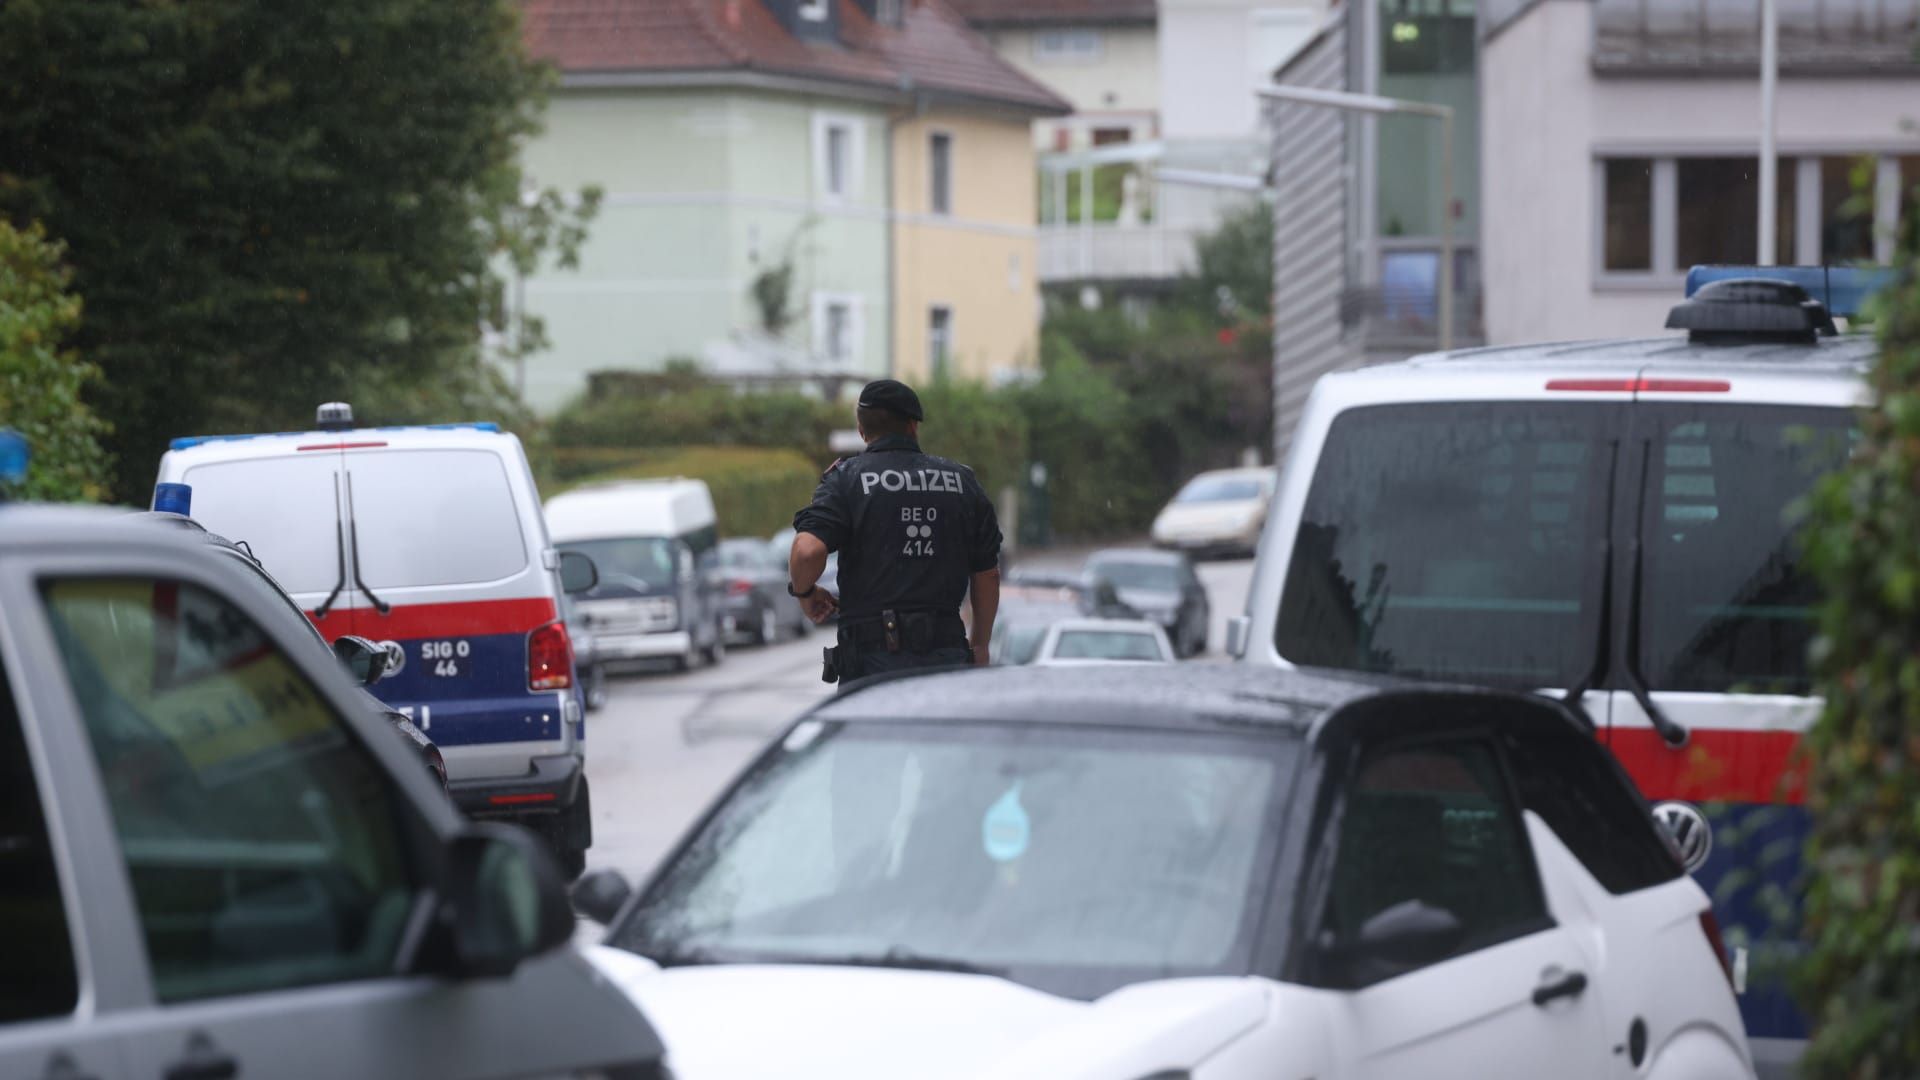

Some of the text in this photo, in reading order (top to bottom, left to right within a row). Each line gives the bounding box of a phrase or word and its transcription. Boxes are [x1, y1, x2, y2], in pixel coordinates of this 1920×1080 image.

[860, 469, 963, 494] POLIZEI
[901, 507, 922, 521] BE
[903, 540, 934, 556] 414
[435, 660, 458, 676] 46
